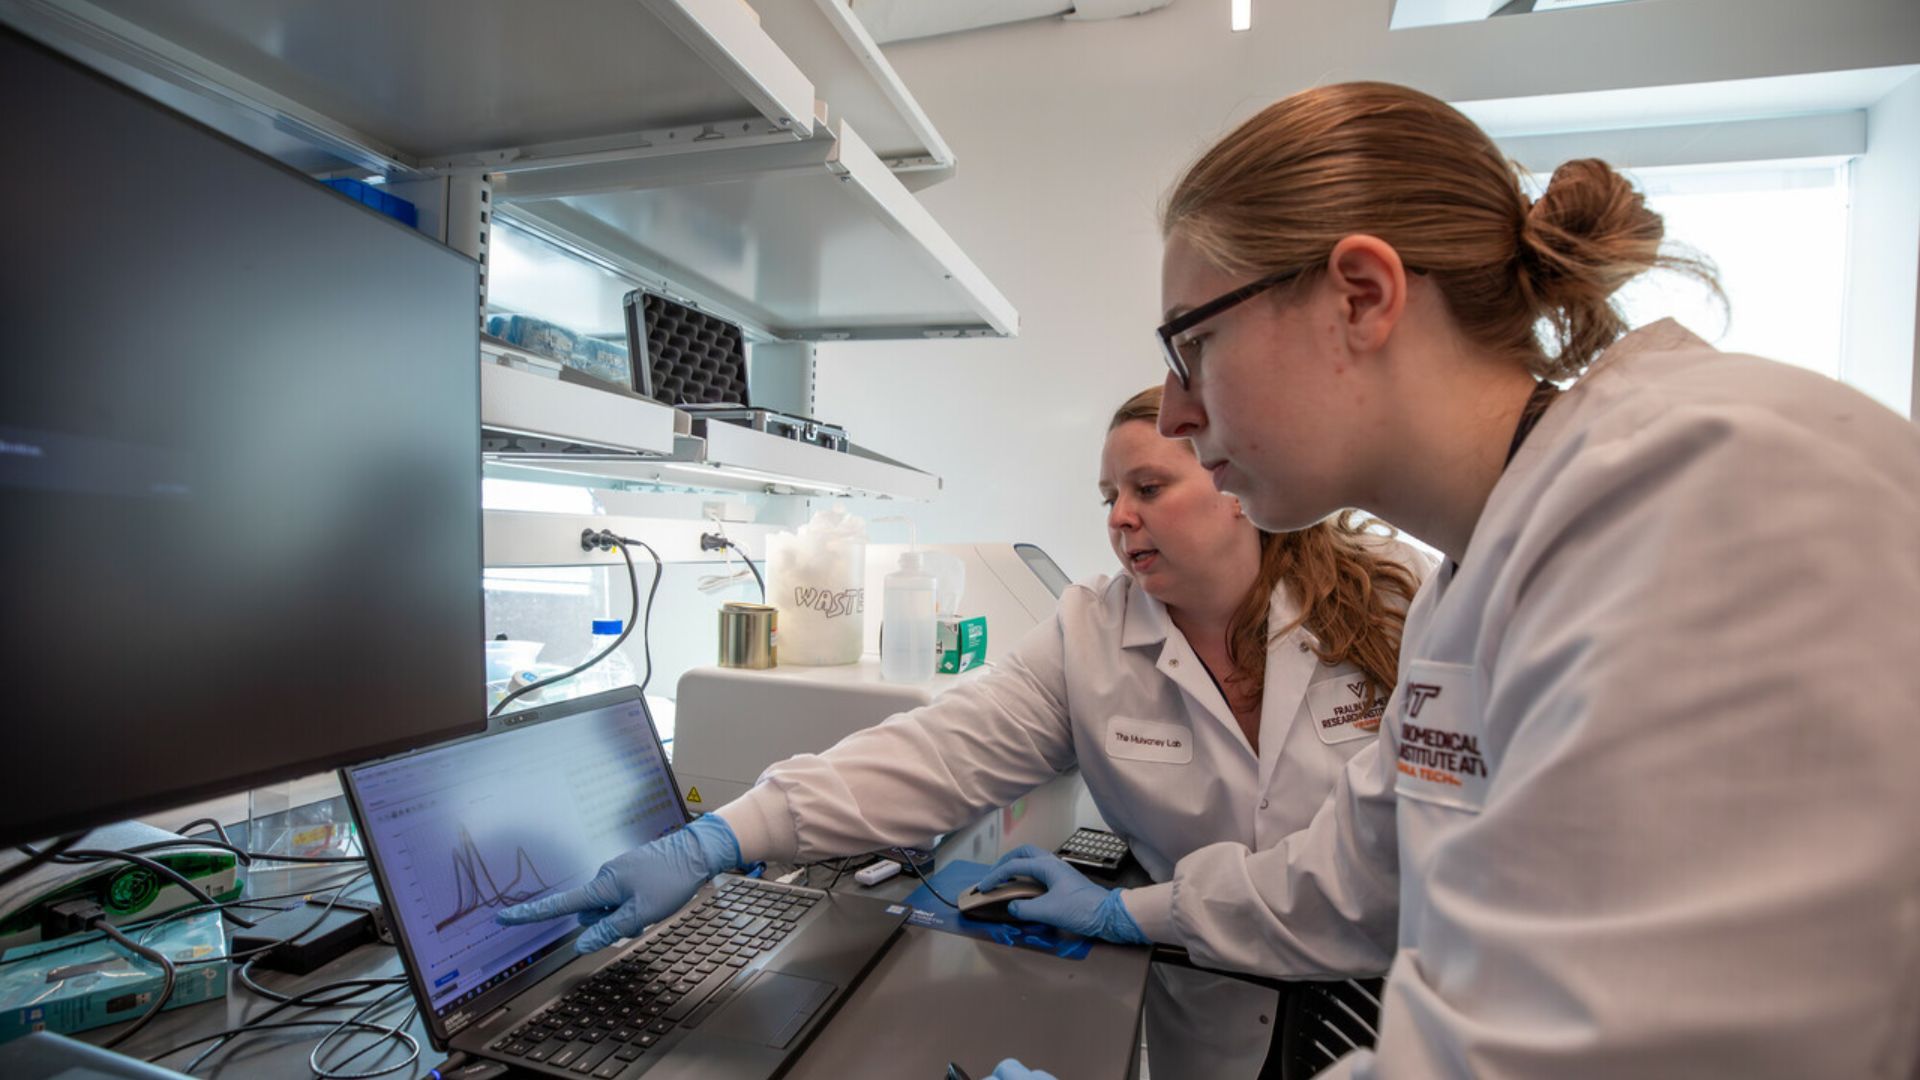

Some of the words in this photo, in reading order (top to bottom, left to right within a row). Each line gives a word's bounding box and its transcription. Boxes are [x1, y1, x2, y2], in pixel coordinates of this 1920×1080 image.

[794, 586, 865, 618] WASTE
[1116, 732, 1129, 742] The
[1166, 739, 1182, 748] Lab
